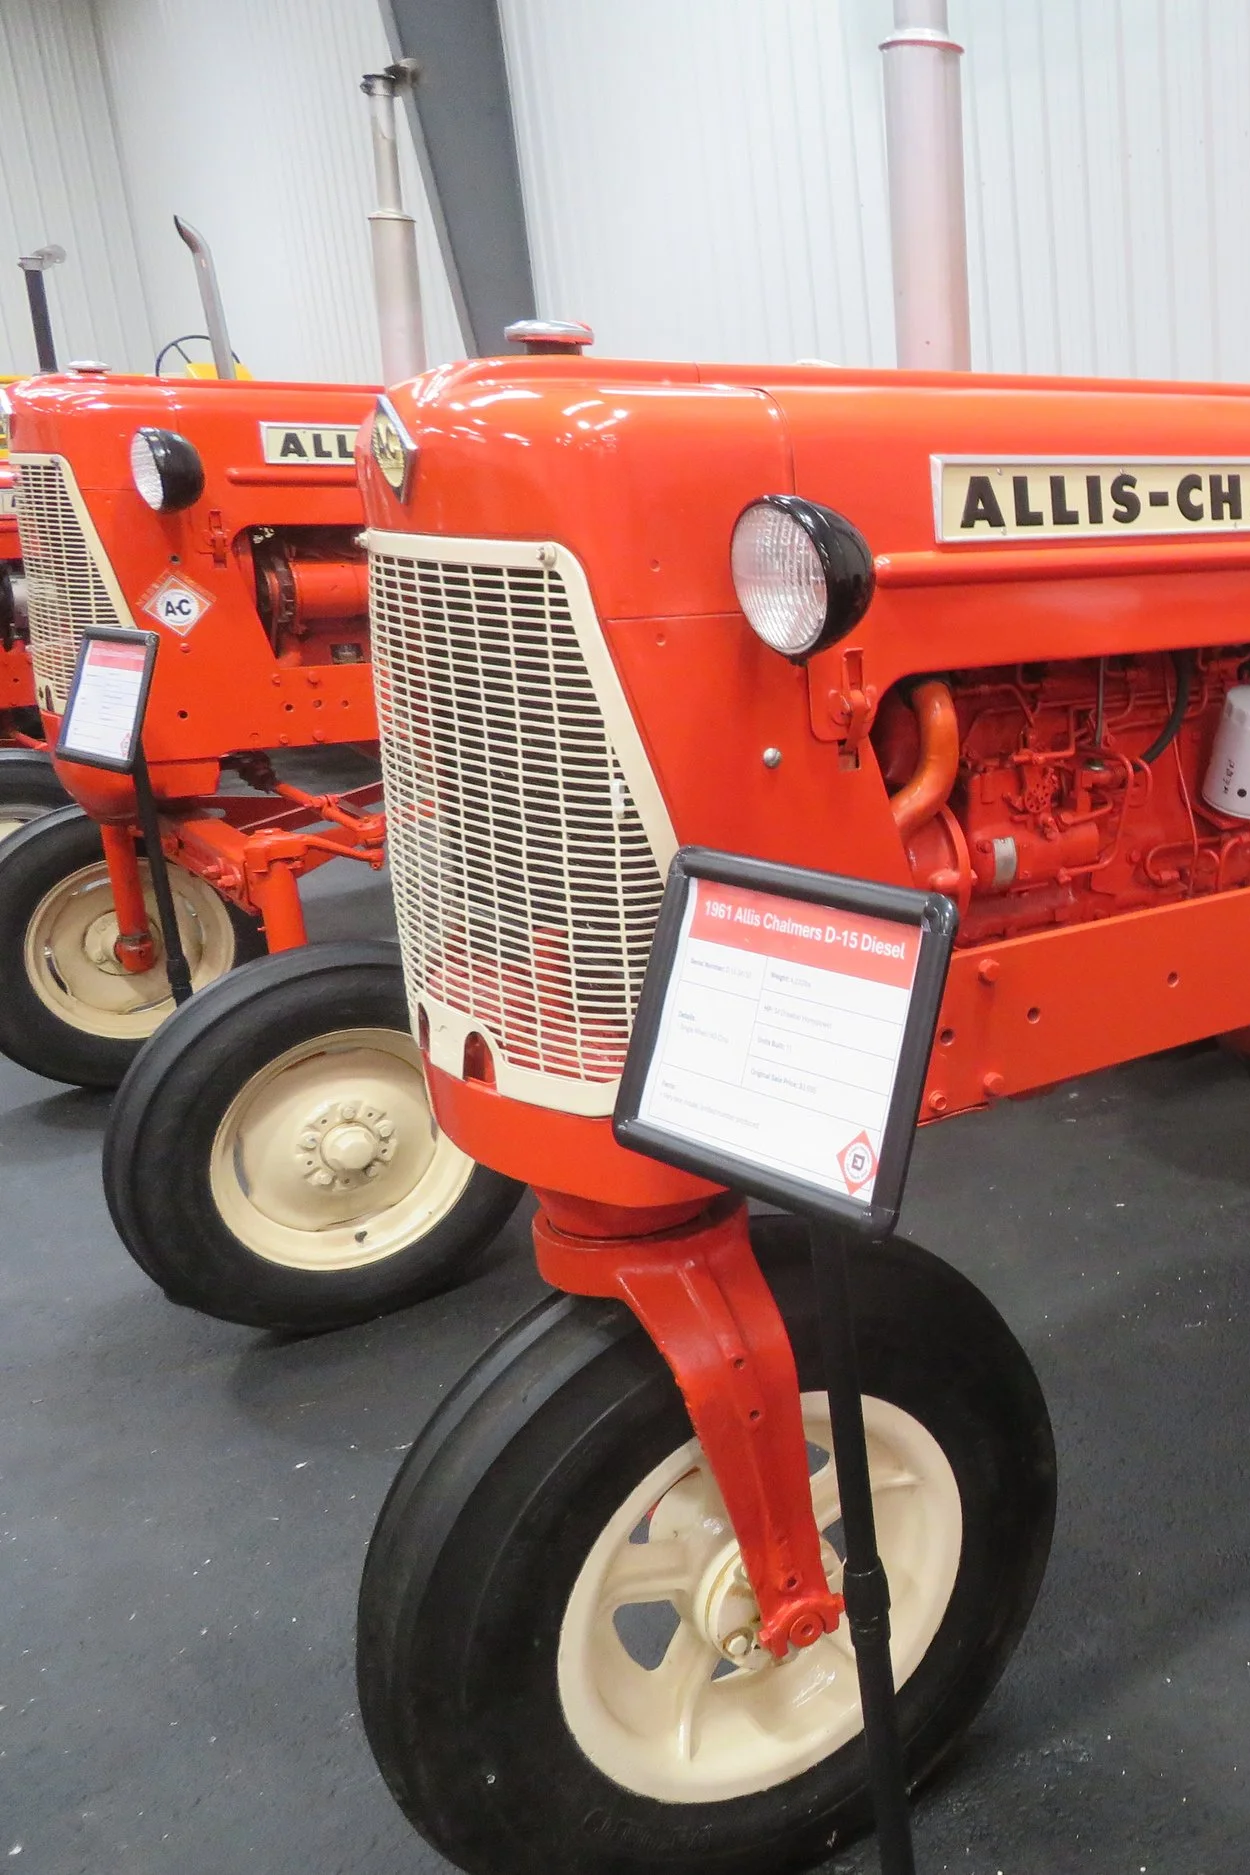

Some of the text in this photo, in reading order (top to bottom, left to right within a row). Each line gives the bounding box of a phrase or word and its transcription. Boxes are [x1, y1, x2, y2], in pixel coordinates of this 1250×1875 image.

[705, 900, 906, 960] 1961 Allis Chalmers D-15 Diesel
